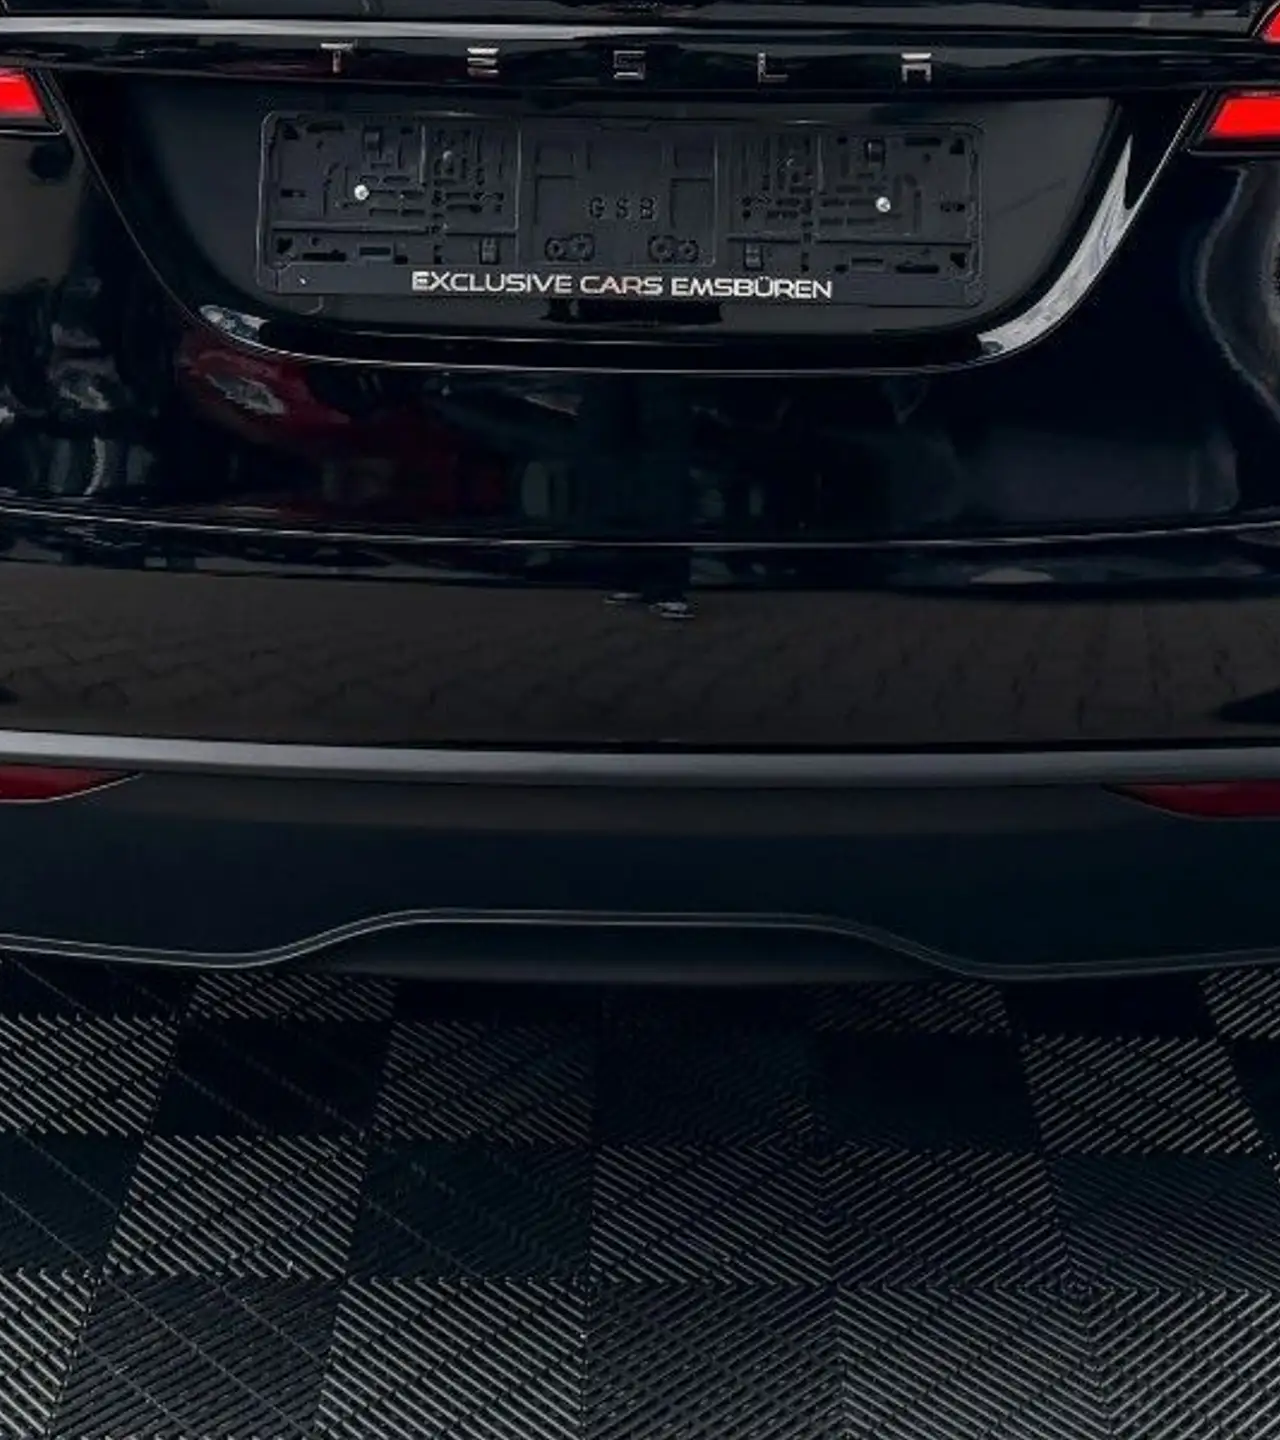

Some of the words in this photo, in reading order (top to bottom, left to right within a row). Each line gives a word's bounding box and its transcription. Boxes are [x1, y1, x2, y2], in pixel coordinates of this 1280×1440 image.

[320, 42, 932, 83] TESLA
[411, 270, 572, 294] EXCLUSIVE
[579, 275, 663, 296] CARS
[671, 276, 832, 299] EMSBÜREN
